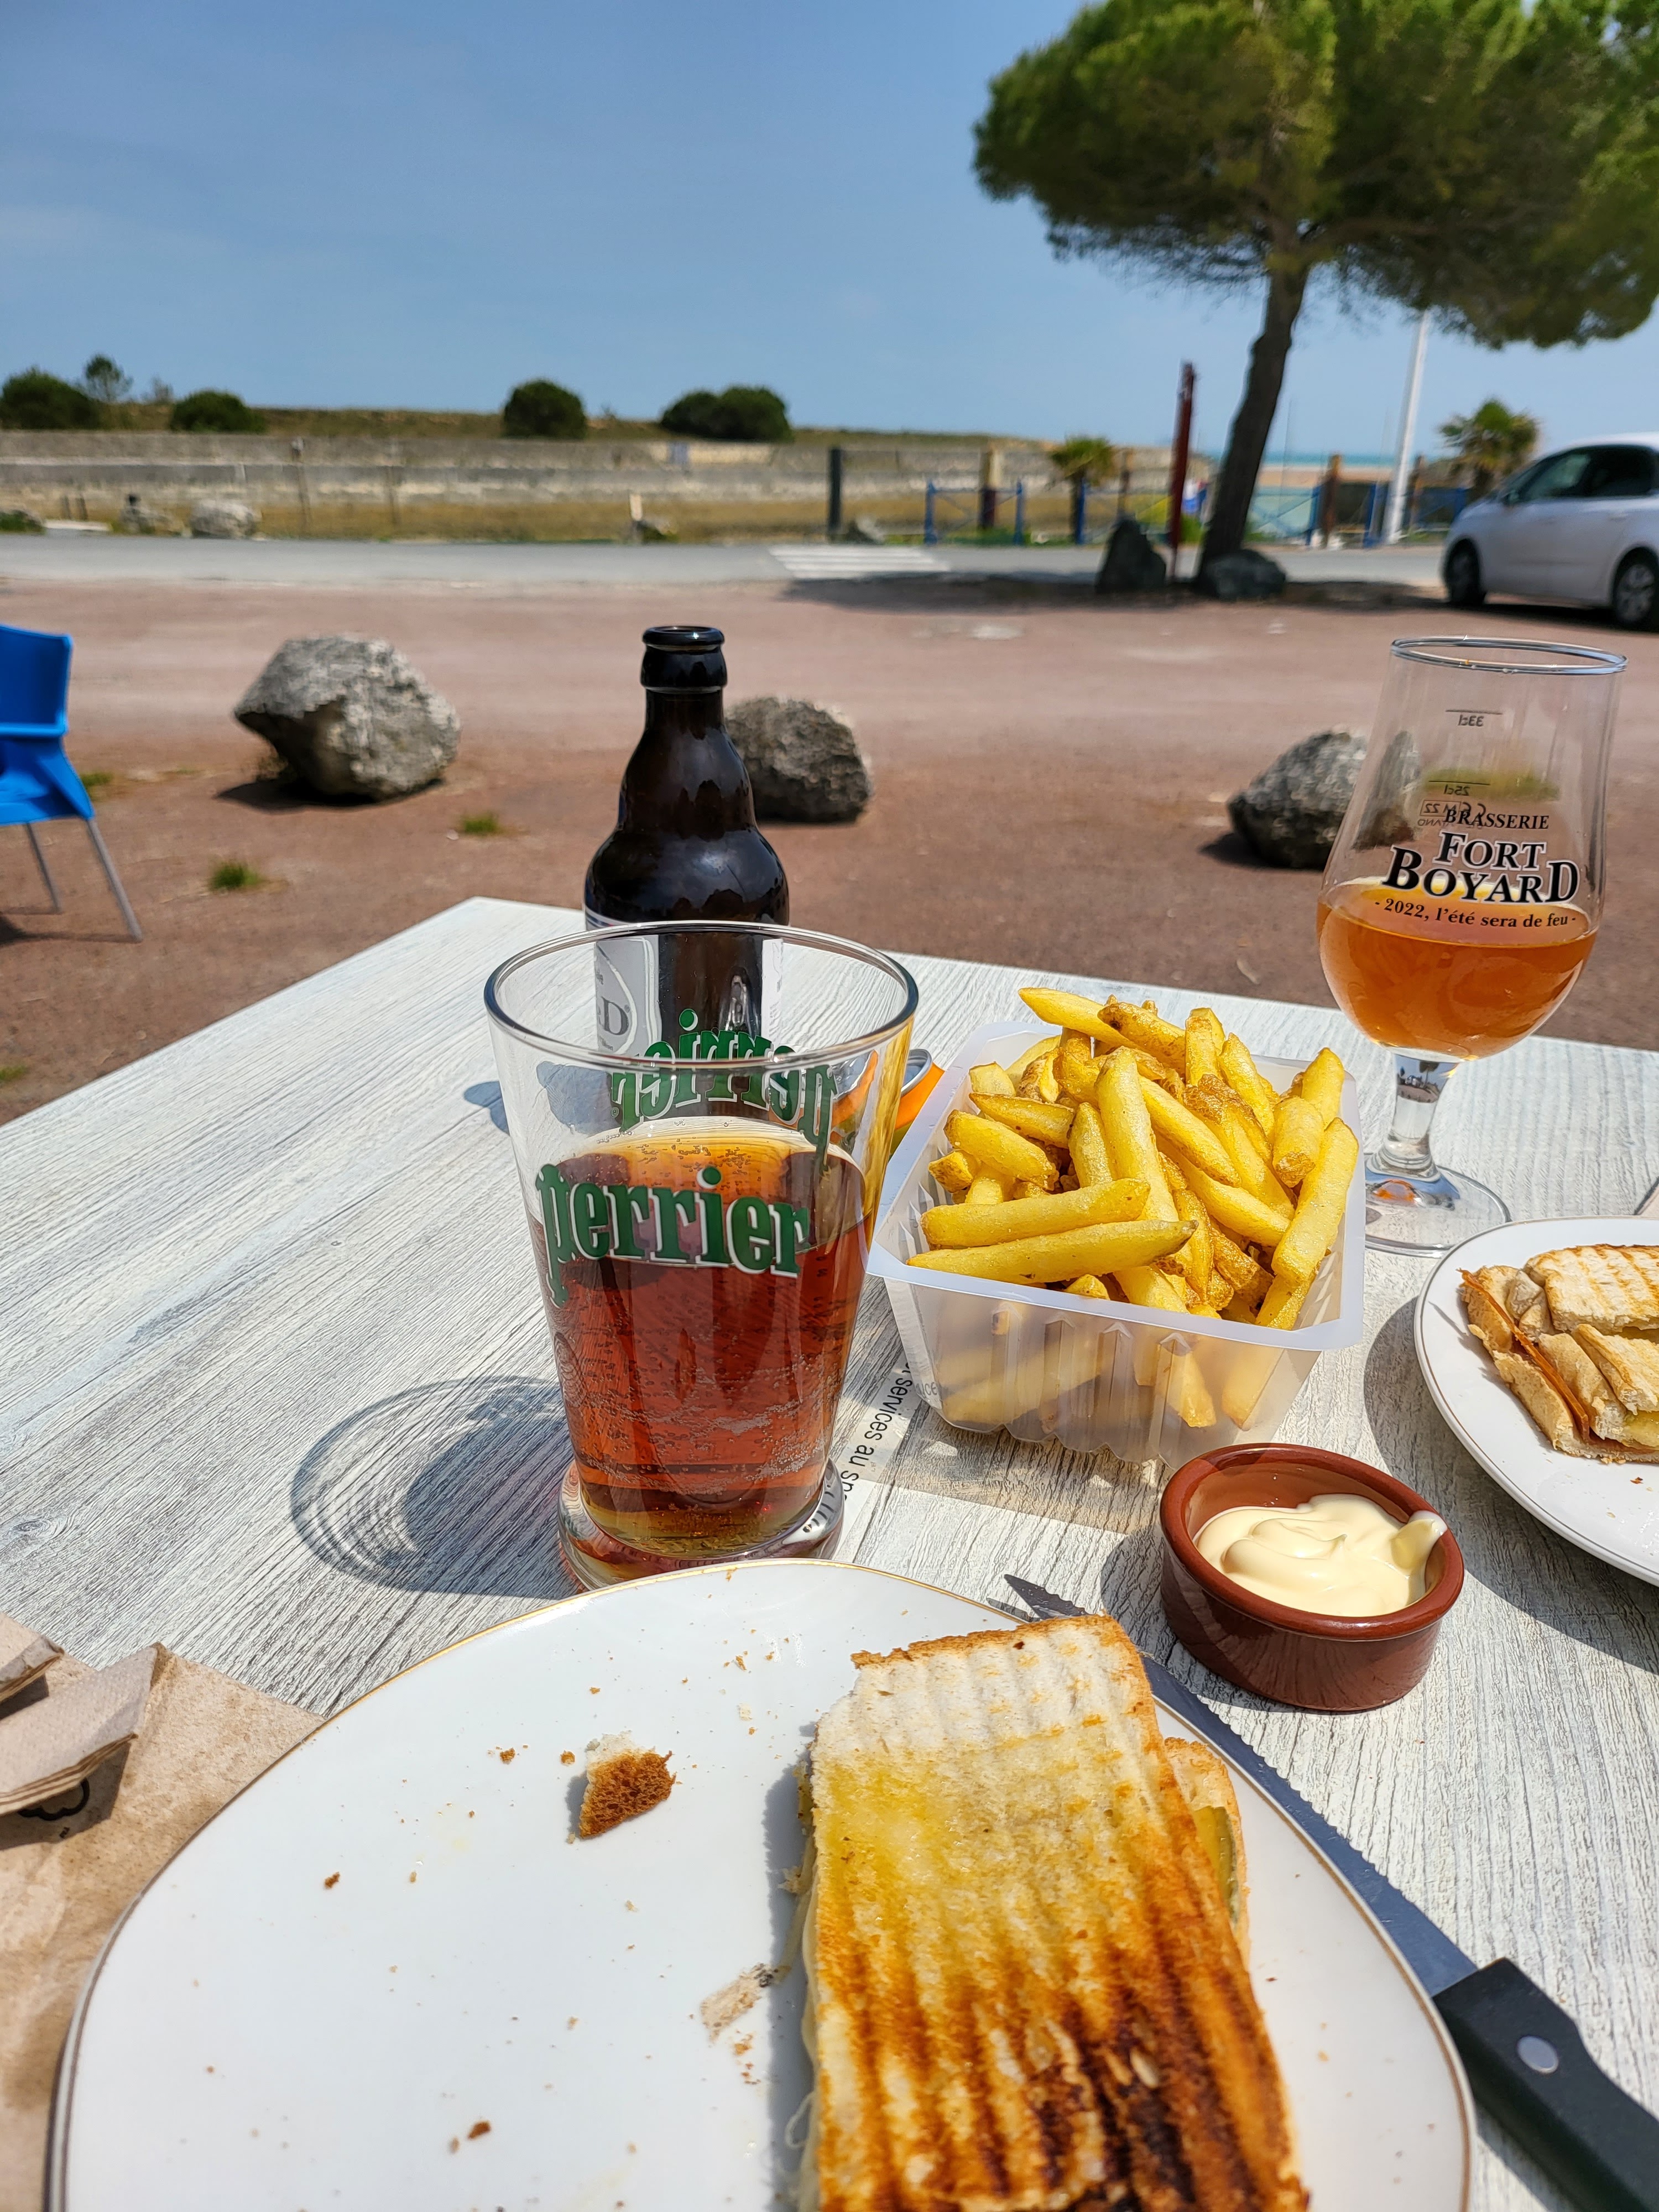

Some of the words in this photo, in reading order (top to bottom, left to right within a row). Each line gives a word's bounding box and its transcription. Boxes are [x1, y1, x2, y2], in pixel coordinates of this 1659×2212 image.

[1443, 809, 1550, 830] BRASSERIE
[1434, 831, 1546, 870] FORT
[1381, 846, 1579, 904] BOYARD
[1384, 898, 1429, 921] 2022,
[1480, 915, 1517, 928] sera
[1523, 914, 1543, 928] de
[1546, 912, 1568, 927] feu
[864, 1378, 913, 1441] services
[848, 1444, 875, 1467] au
